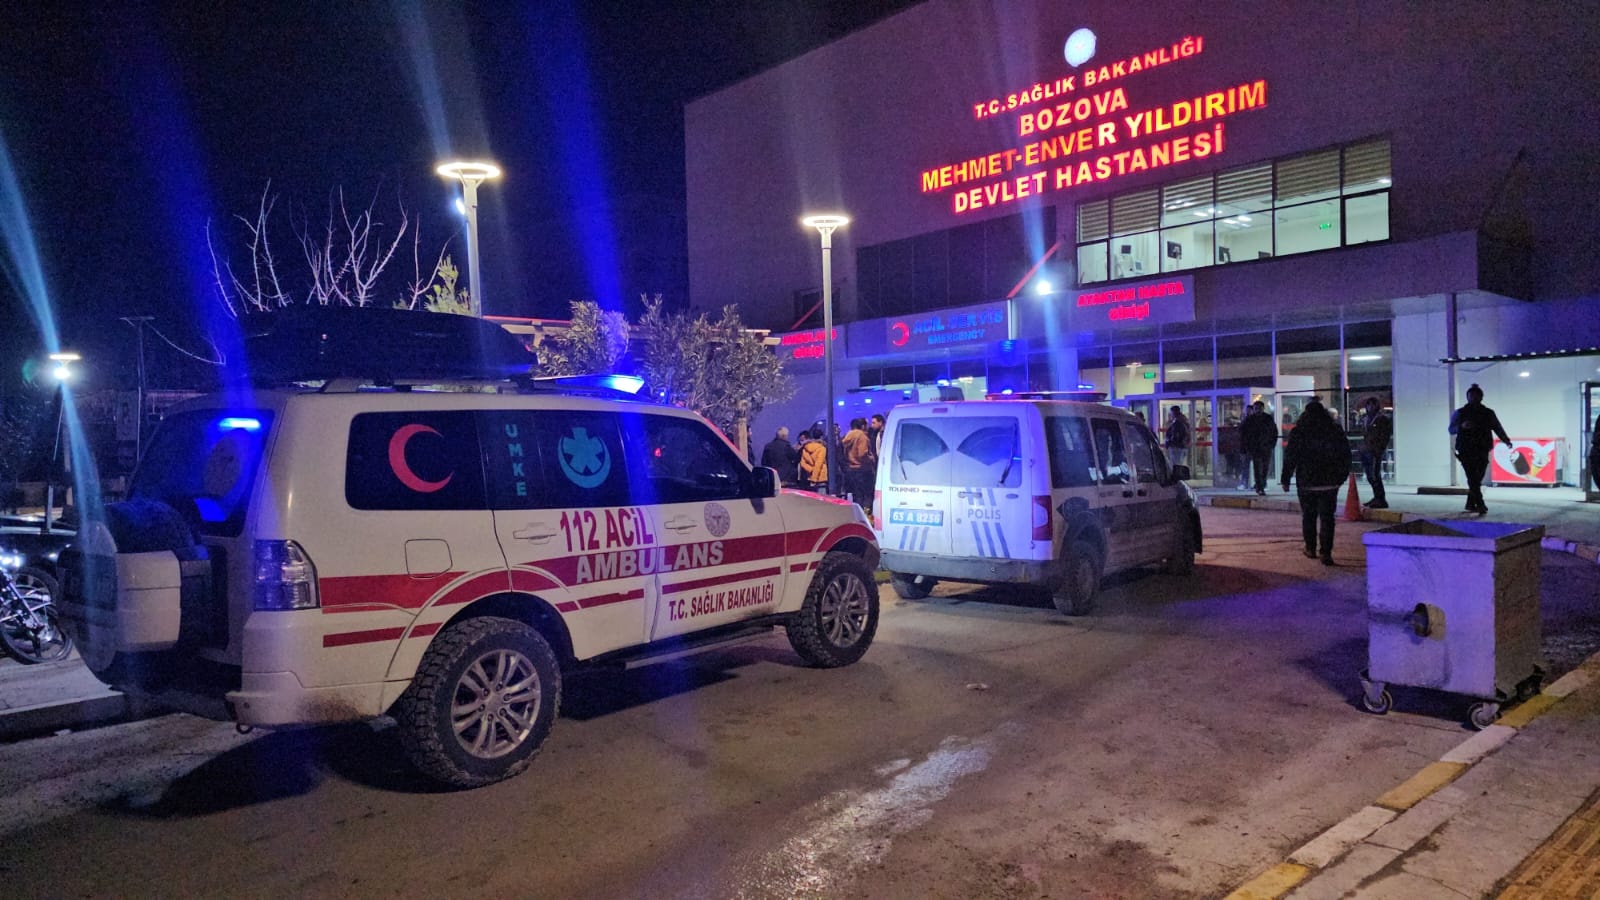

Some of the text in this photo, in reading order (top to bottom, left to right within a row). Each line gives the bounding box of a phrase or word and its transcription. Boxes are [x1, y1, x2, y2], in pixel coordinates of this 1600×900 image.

[1083, 36, 1204, 87] BAKANLIĞI
[921, 79, 1267, 193] MEHMET-ENVER YILDIRIM
[1019, 86, 1128, 137] BOZOVA
[954, 123, 1225, 214] DEVLET HASTANESİ
[560, 510, 600, 553] 112
[576, 541, 724, 584] AMBULANS
[691, 589, 725, 617] SAĞLIK
[727, 580, 774, 610] BAKANLIĞI
